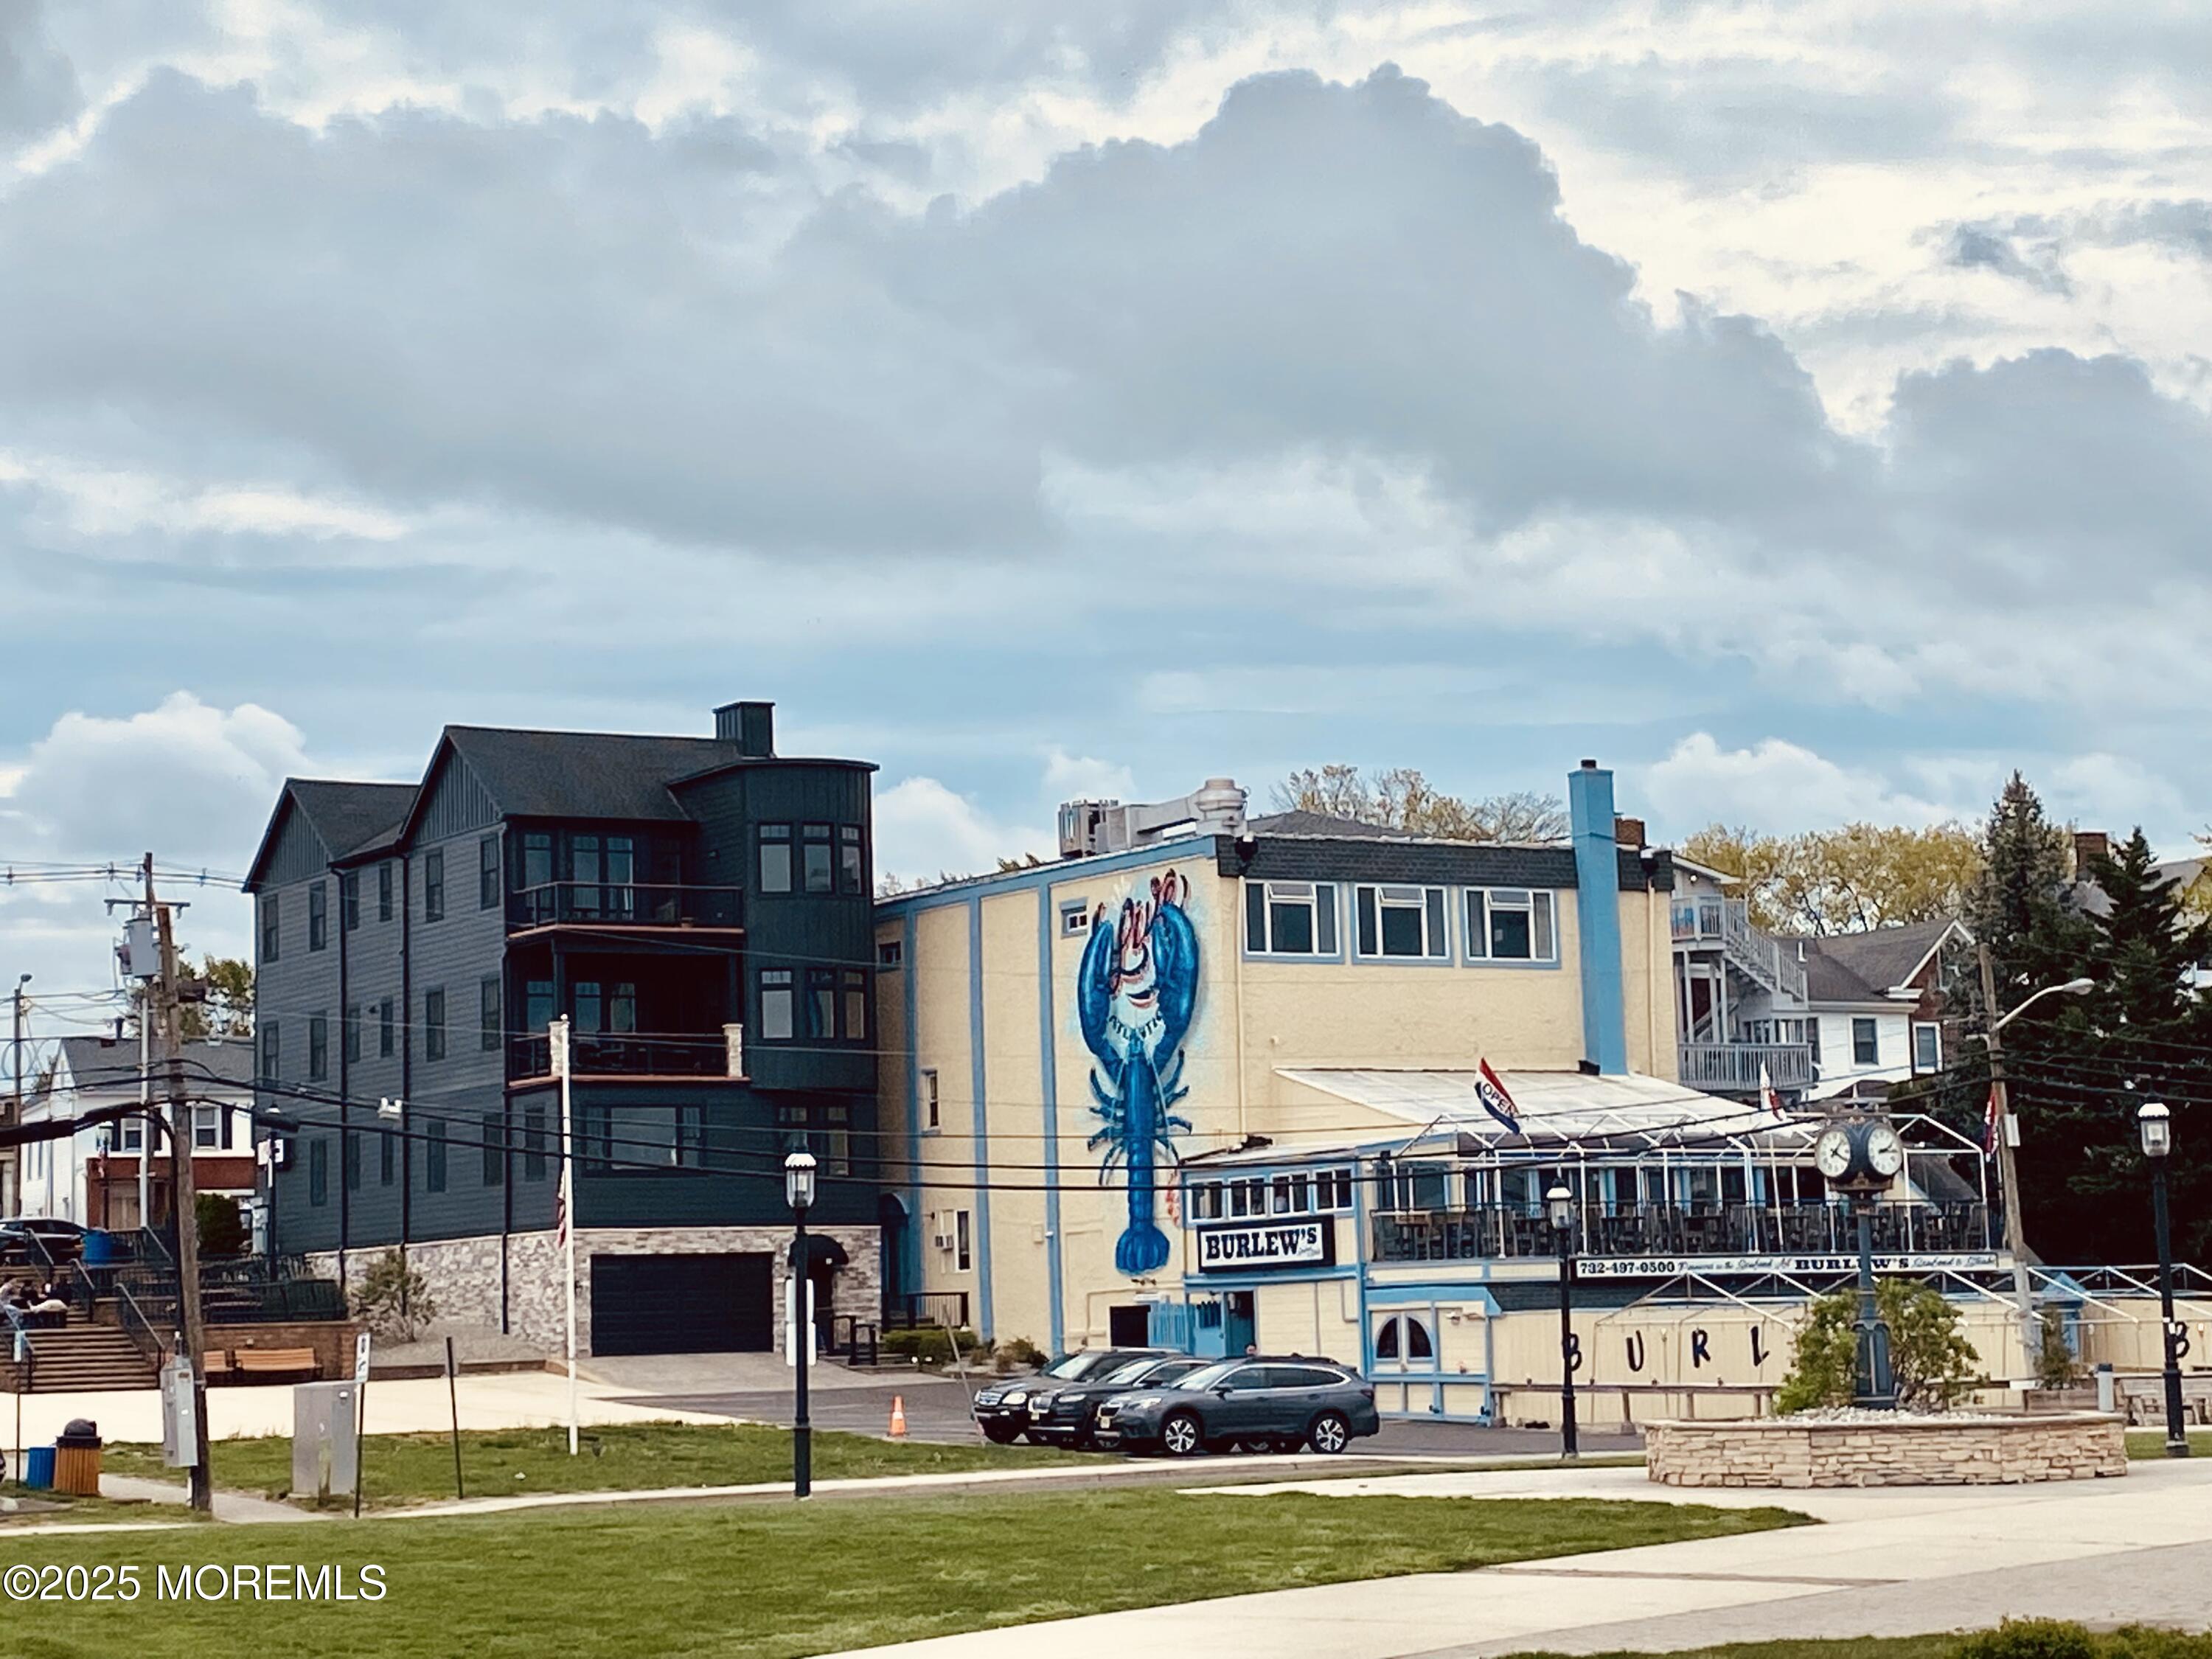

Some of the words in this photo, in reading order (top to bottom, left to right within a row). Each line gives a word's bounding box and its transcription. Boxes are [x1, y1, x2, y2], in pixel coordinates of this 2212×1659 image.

[1108, 1010, 1162, 1040] ATLNTIC
[1483, 1082, 1519, 1119] OPEN
[1205, 1227, 1317, 1259] BURLEW'S
[1580, 1261, 1674, 1274] 732-497-0500
